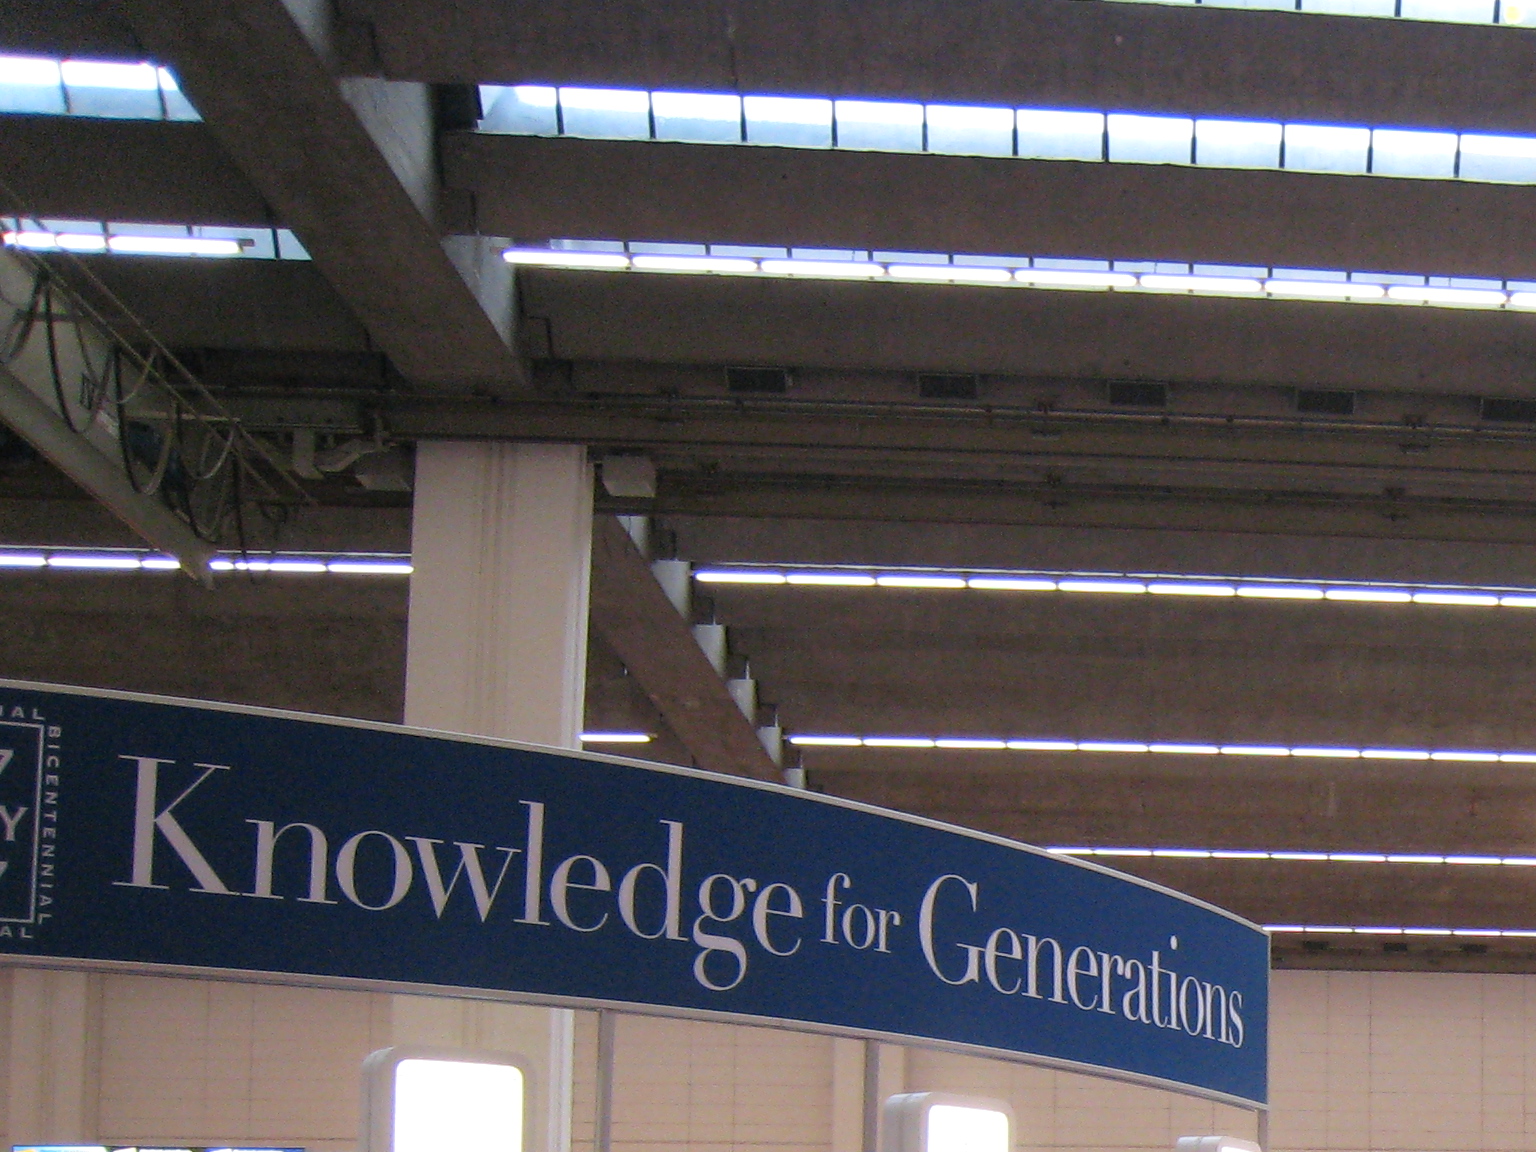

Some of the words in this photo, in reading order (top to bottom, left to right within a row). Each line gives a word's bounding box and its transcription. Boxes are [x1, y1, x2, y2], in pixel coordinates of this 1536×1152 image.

[38, 725, 62, 925] BICENTENNIAL
[112, 754, 803, 991] Knowledge
[819, 872, 901, 954] for
[918, 873, 1244, 1048] Generations
